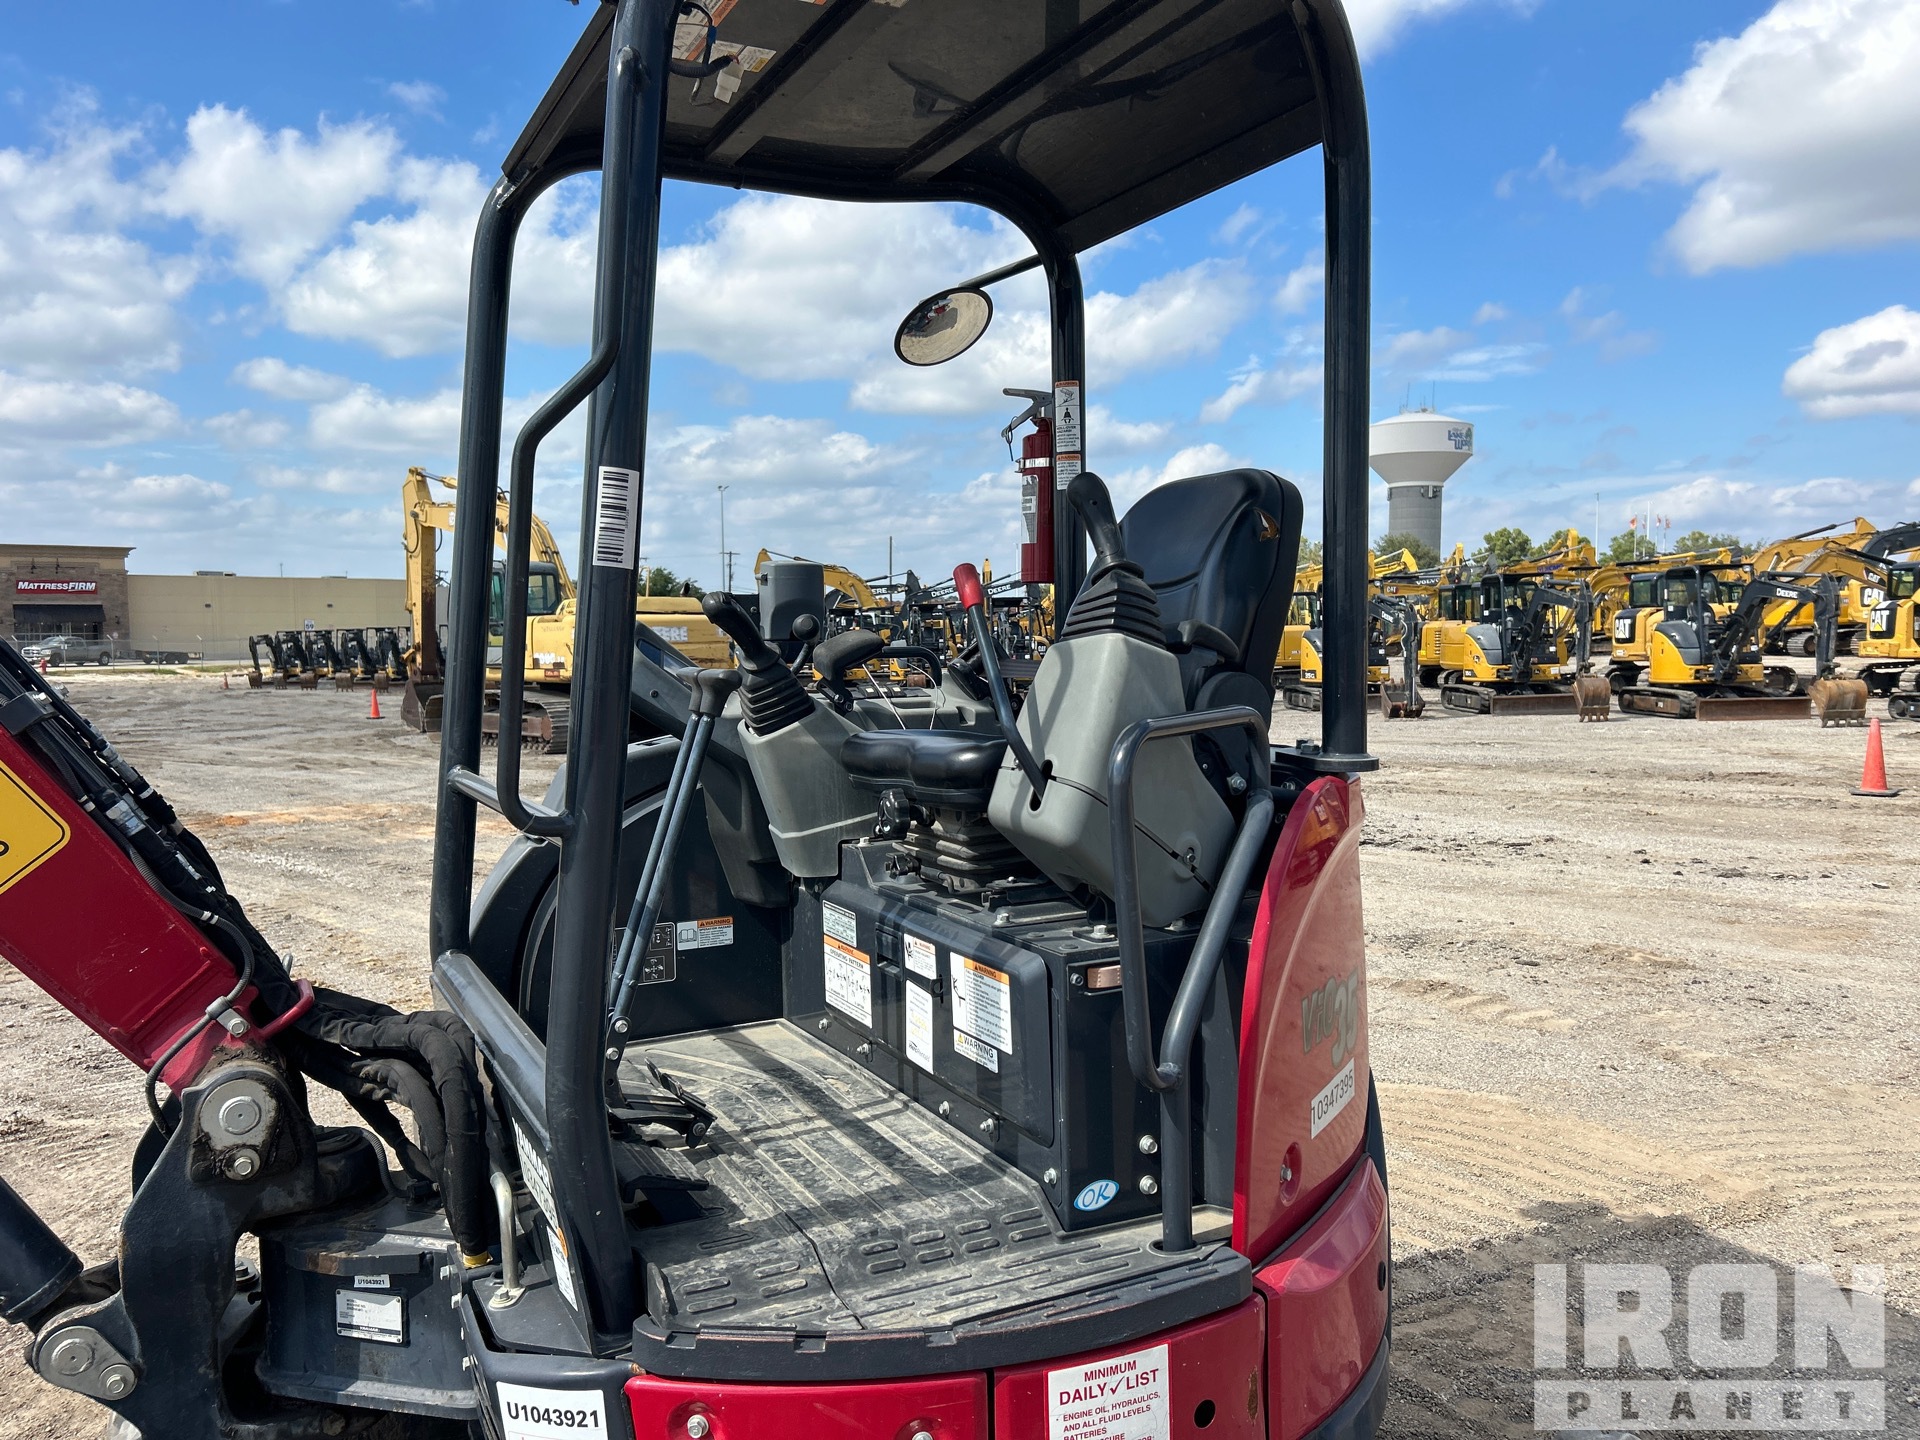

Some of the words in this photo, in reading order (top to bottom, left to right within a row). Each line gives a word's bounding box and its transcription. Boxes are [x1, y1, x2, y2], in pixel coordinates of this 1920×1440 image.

[1868, 573, 1880, 583] CAT
[931, 587, 955, 598] DEERE
[988, 584, 1012, 595] DEERE
[1776, 588, 1799, 599] DEERE
[1864, 588, 1884, 605] CAT
[1615, 619, 1631, 639] CAT
[1870, 610, 1890, 631] CAT
[705, 918, 731, 926] WARNING
[978, 964, 997, 978] WARNING
[963, 1036, 994, 1058] WARNING
[1311, 1070, 1355, 1125] 10347395
[1081, 1182, 1112, 1208] OK
[1084, 1360, 1137, 1382] MINIMUM
[1059, 1382, 1107, 1406] DAILY
[1126, 1369, 1159, 1390] LIST
[507, 1401, 599, 1428] U1043921
[1063, 1409, 1093, 1422] ENGINE
[1095, 1406, 1110, 1415] OIL,
[1111, 1391, 1161, 1411] HYDRAULICS,
[1063, 1423, 1080, 1433] AND
[1082, 1419, 1097, 1429] ALL
[1099, 1413, 1121, 1425] FLUID
[1122, 1405, 1151, 1418] LEVELS
[1064, 1427, 1107, 1440] BATTERIES
